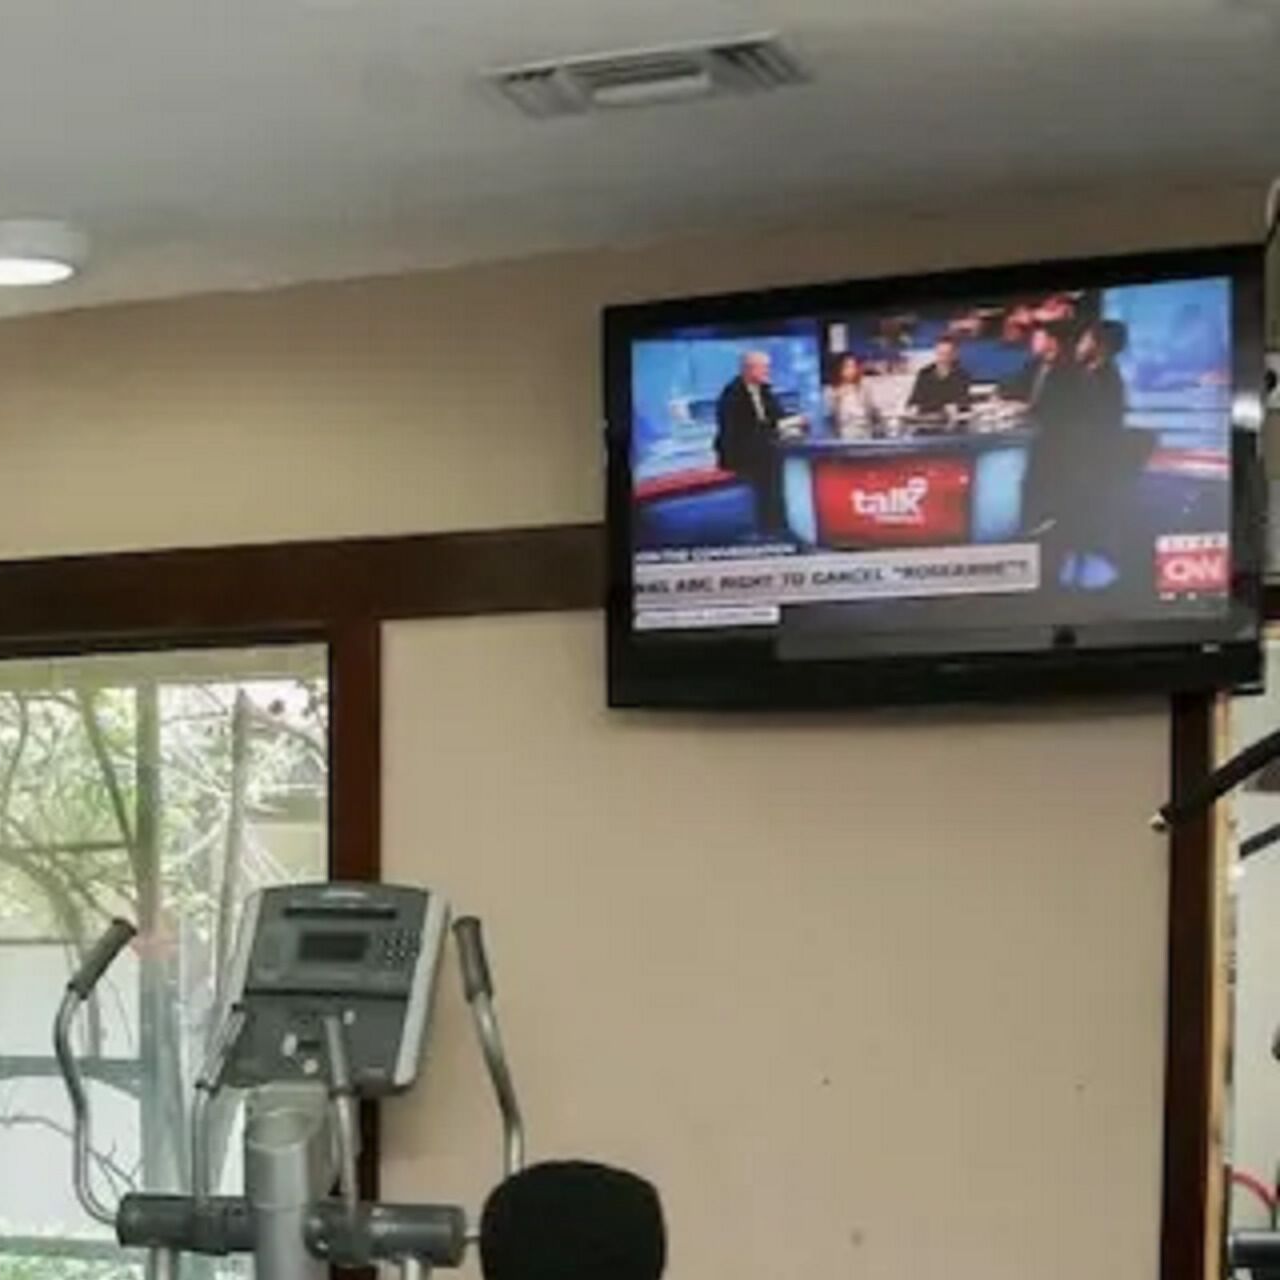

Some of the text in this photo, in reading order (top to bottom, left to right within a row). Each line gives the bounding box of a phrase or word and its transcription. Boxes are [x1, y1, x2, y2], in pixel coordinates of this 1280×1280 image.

[675, 576, 713, 593] ABC
[720, 573, 773, 591] RIGHT
[781, 571, 806, 586] TO
[811, 566, 883, 585] CANCEL
[1162, 555, 1224, 582] CNN
